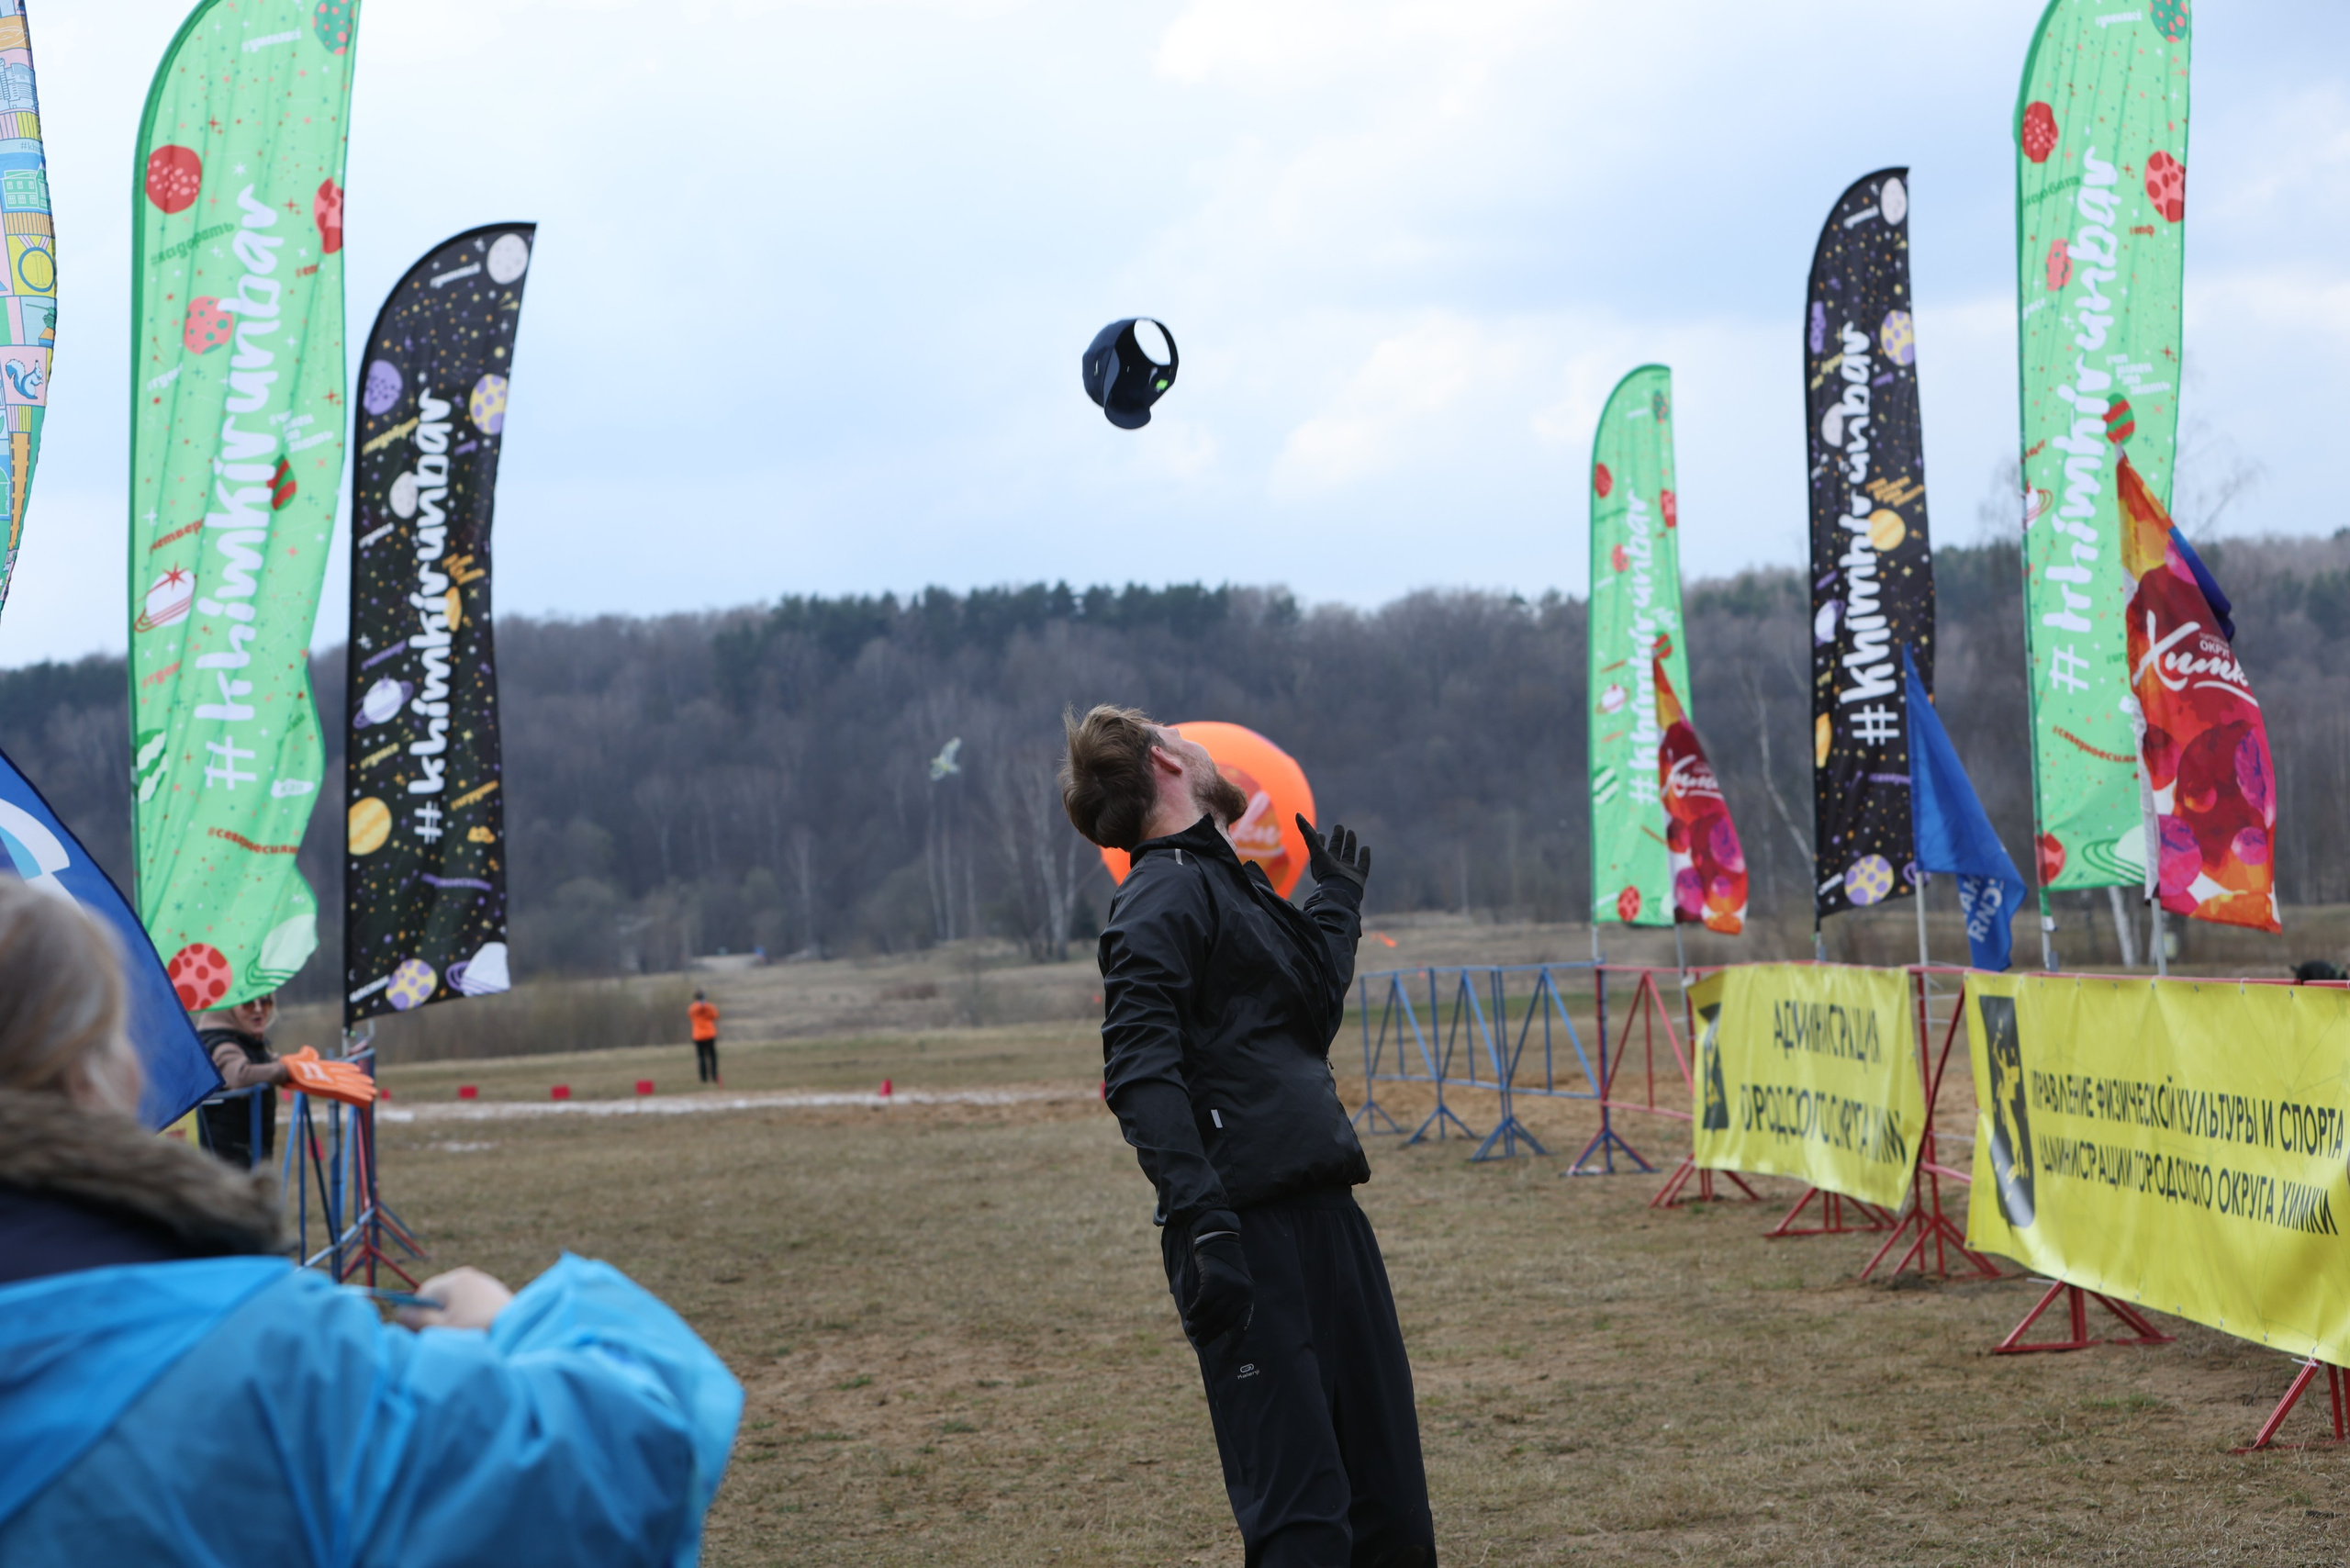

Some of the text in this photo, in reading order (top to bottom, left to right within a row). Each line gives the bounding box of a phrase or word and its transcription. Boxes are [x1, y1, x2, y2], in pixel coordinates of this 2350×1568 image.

[408, 386, 453, 845] #khimkirunbar
[2096, 1074, 2177, 1131] ФИЗИЧЕСКОЙ
[2177, 1088, 2258, 1146] КУЛЬТУРЫ
[2261, 1099, 2274, 1148] И
[2279, 1101, 2344, 1159] СПОРТА
[2218, 1168, 2275, 1224] ОКРУГА
[2277, 1180, 2339, 1236] ХИМКИ
